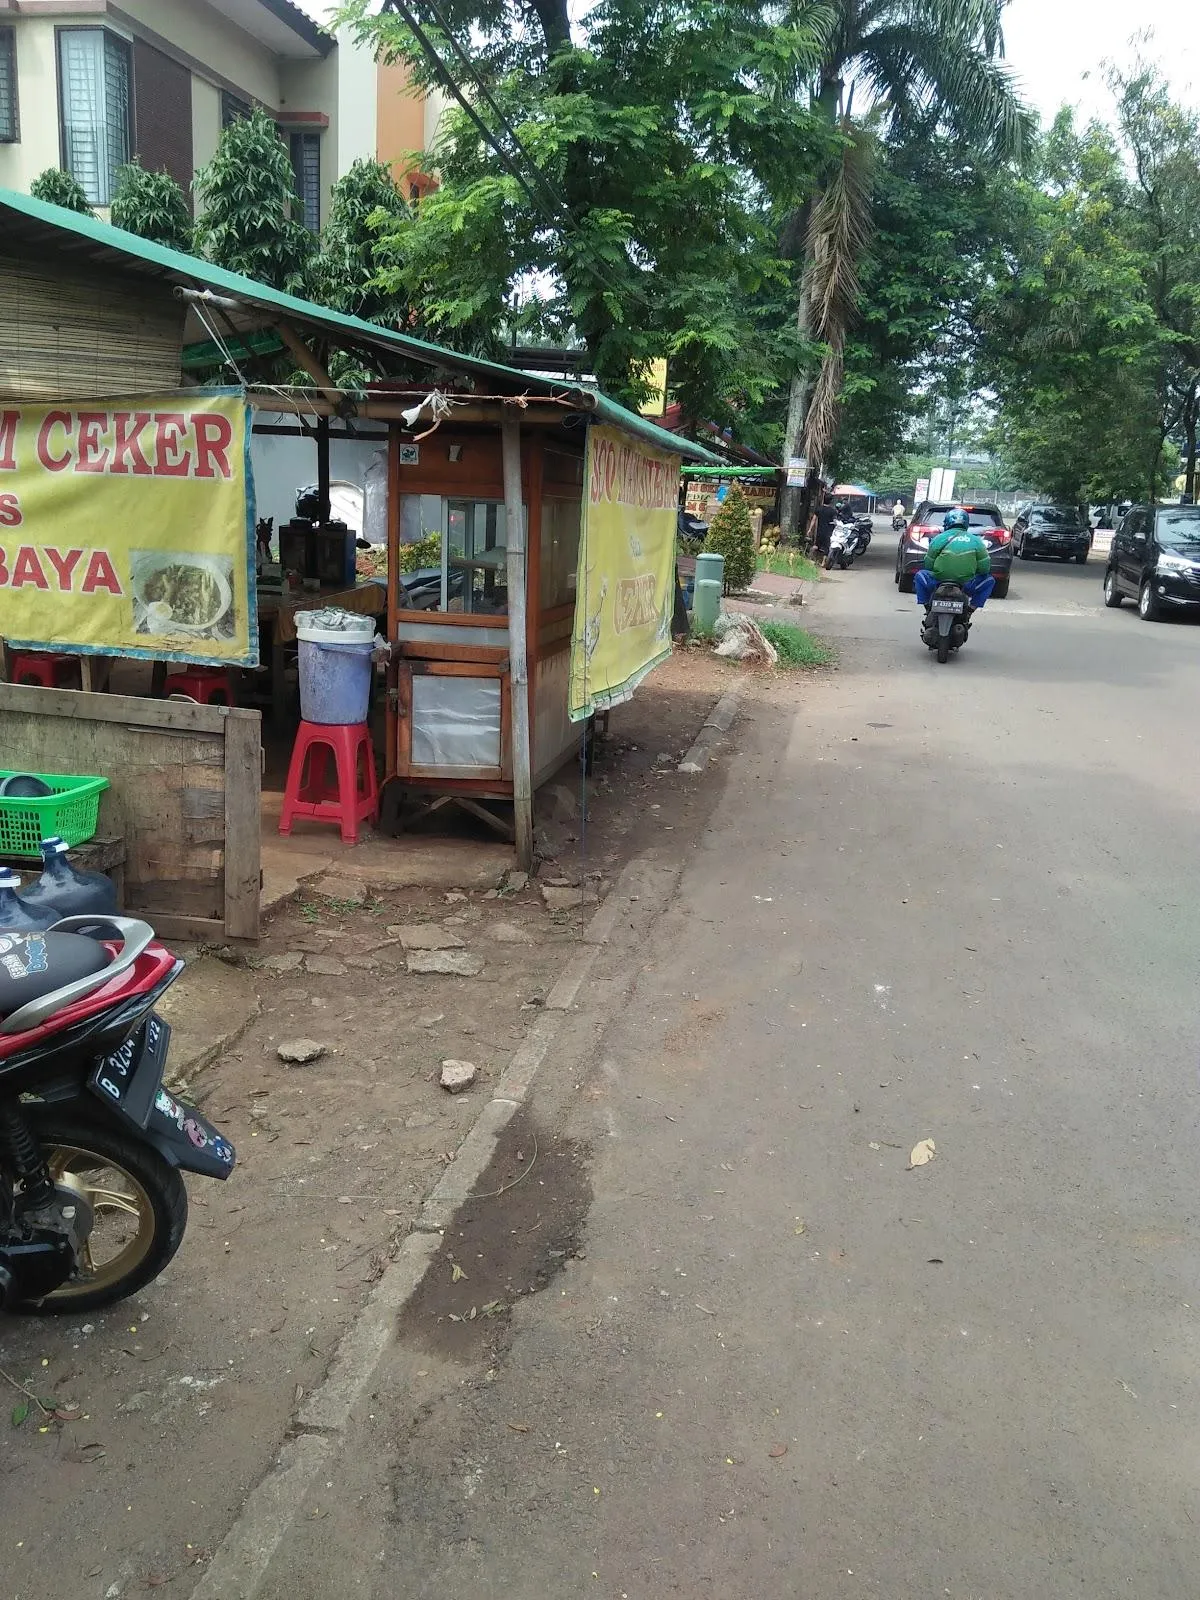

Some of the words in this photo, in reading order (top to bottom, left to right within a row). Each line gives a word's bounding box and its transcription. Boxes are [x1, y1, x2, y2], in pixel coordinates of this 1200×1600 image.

[37, 410, 232, 478] CEKER
[0, 546, 123, 594] AYA
[101, 1078, 120, 1098] B
